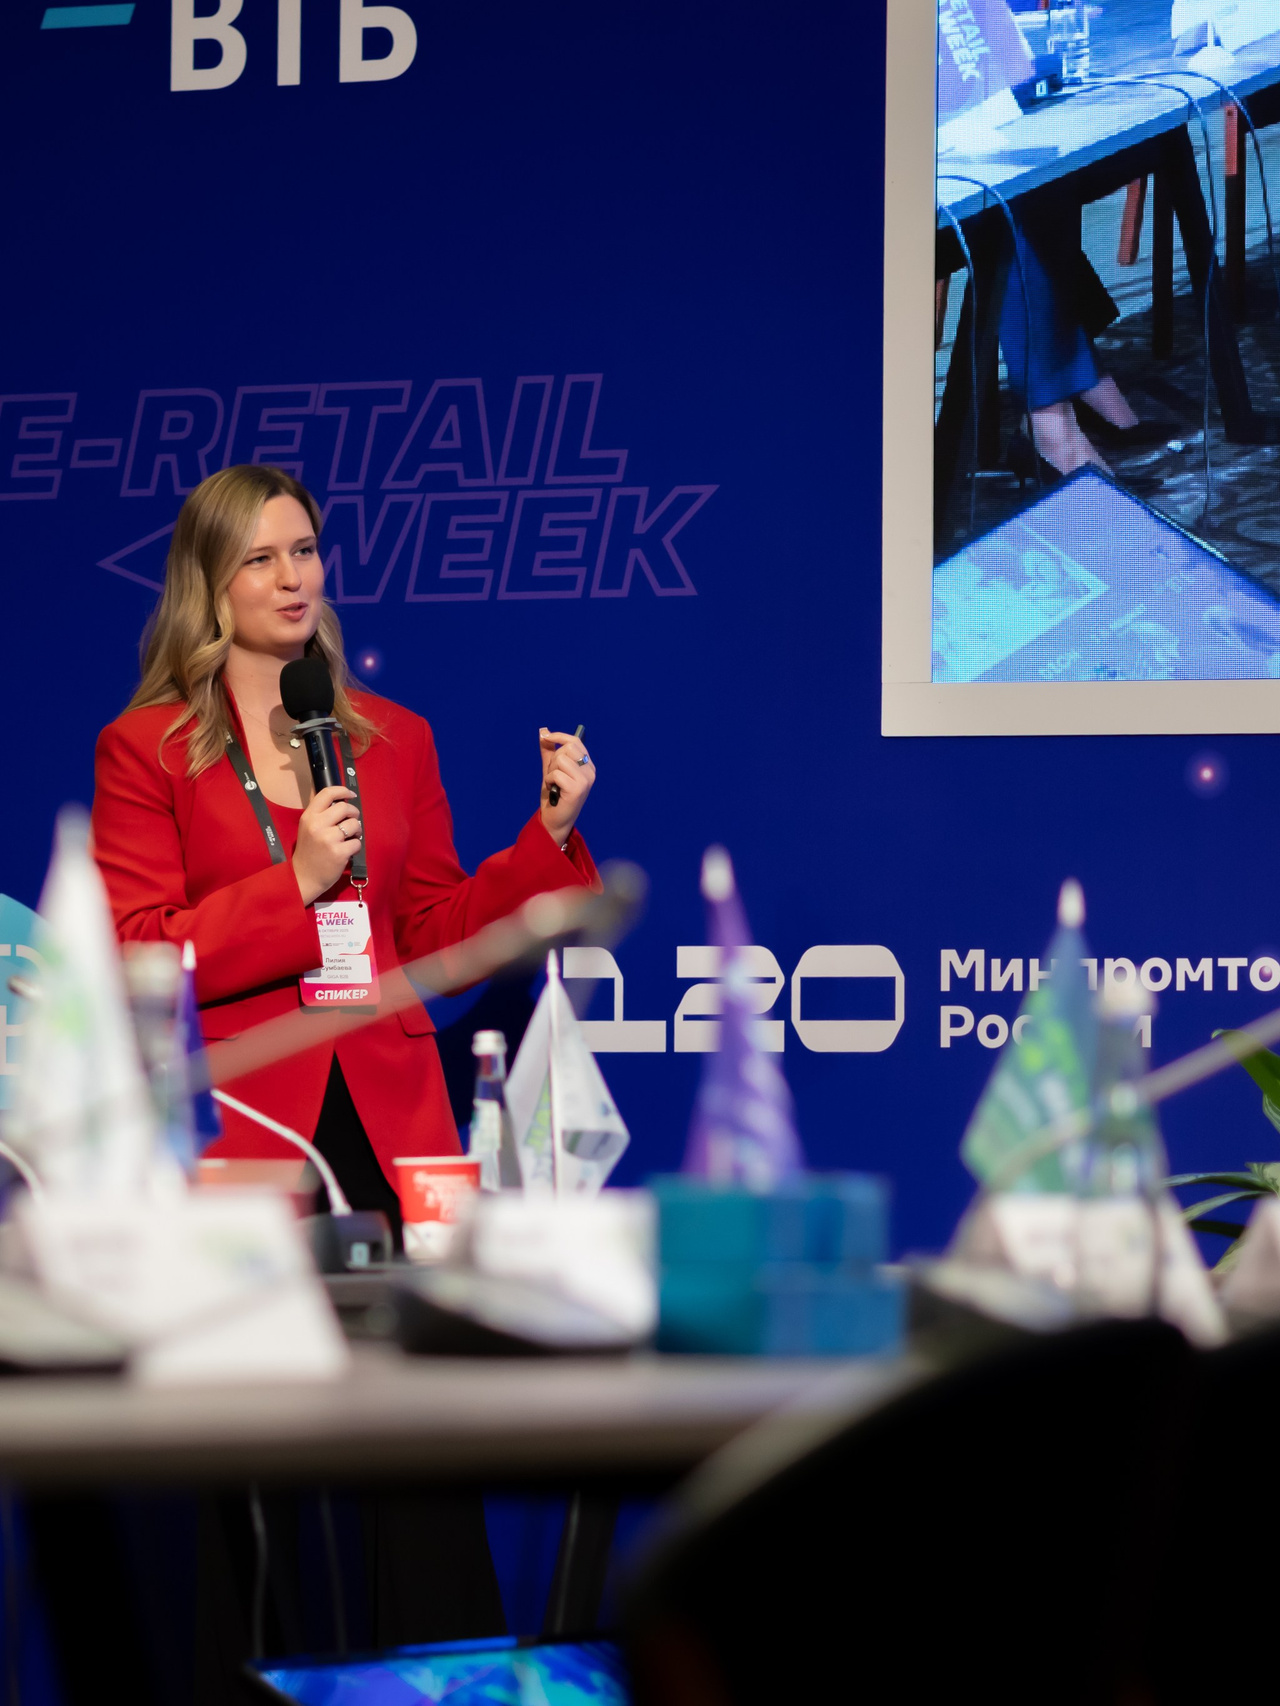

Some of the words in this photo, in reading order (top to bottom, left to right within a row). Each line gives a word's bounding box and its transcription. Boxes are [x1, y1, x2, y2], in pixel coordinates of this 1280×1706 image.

[317, 484, 720, 604] WEEK
[326, 918, 355, 926] WEEK
[315, 989, 368, 1000] СПИКЕР
[940, 1005, 1152, 1049] Рос
